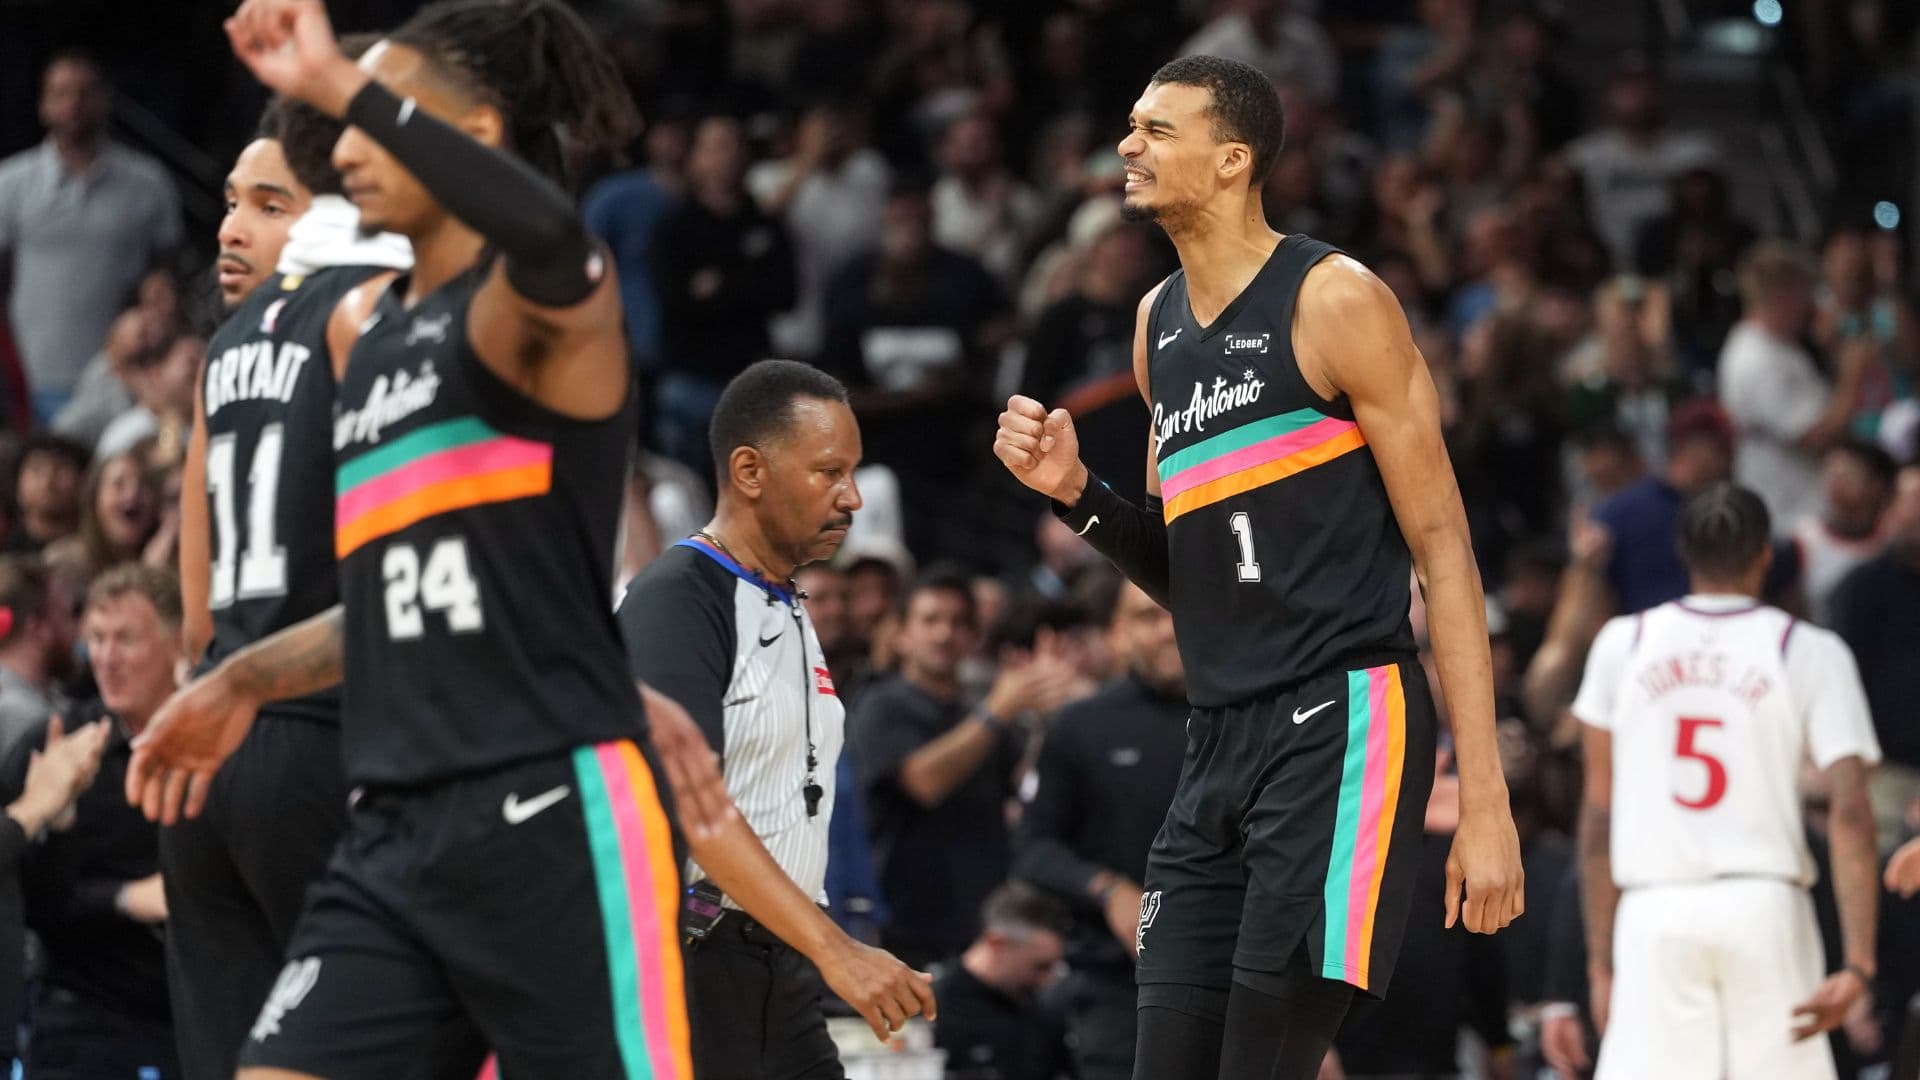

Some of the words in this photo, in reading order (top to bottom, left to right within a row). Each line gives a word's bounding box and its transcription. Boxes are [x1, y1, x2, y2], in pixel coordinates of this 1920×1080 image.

[206, 341, 310, 417] BRYANT
[1230, 339, 1263, 349] LEDGER
[1152, 402, 1180, 456] San
[1181, 371, 1265, 432] Antonio
[206, 422, 287, 609] 11
[1230, 512, 1261, 582] 1
[382, 535, 484, 641] 24
[1672, 716, 1728, 812] 5
